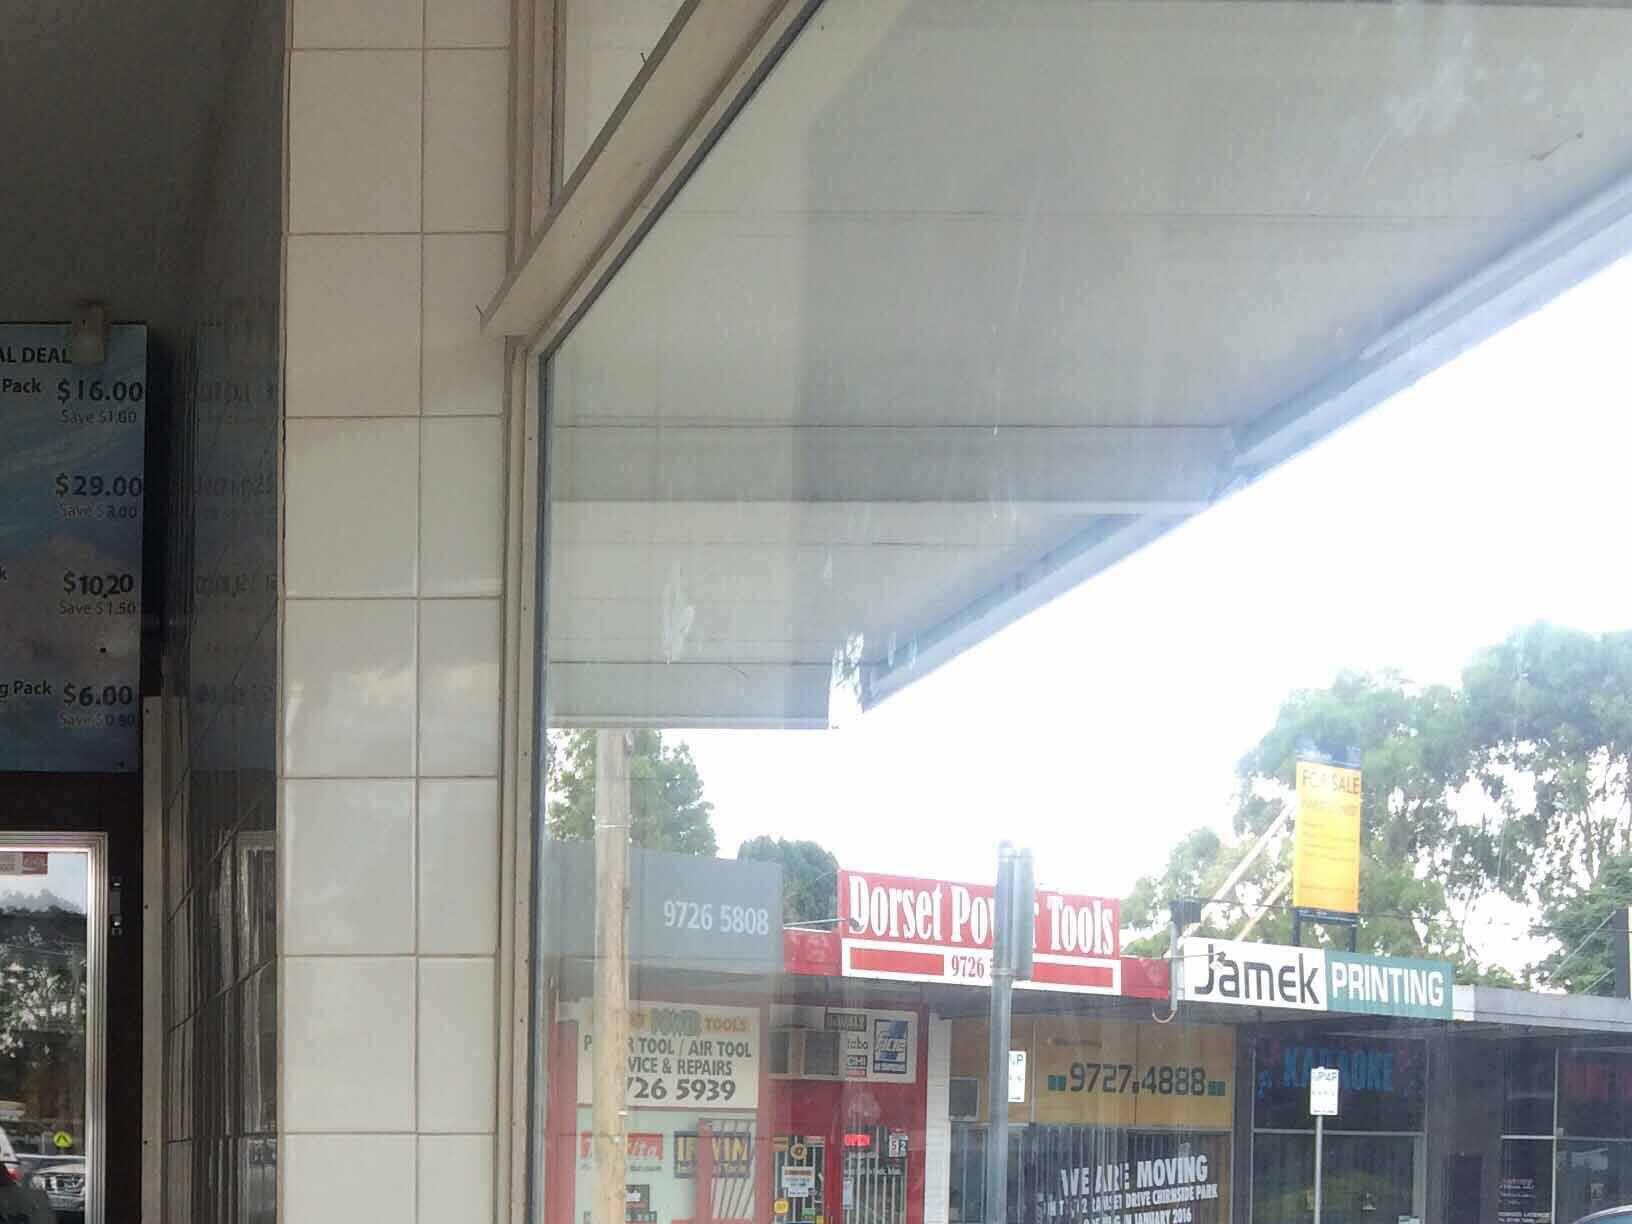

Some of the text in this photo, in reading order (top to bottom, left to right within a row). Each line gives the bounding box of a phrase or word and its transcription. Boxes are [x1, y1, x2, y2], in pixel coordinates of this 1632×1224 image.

[2, 378, 41, 393] Pack
[57, 378, 143, 403] $16.00
[56, 474, 143, 498] $29.00
[13, 680, 52, 695] Pack
[63, 683, 132, 706] $6.00
[1332, 774, 1359, 793] SALE
[664, 901, 769, 935] 9726 5808
[849, 876, 943, 942] Dorset
[1047, 896, 1114, 954] Tools
[952, 956, 984, 978] 9726
[1194, 943, 1444, 1007] Jamek PRINTING
[704, 1017, 746, 1032] TOOLS
[640, 1039, 675, 1054] TOOL
[689, 1041, 712, 1056] AIR
[717, 1042, 751, 1057] TOOL
[628, 1058, 732, 1075] VICE & REPAIRS
[676, 1079, 735, 1100] 5939
[1061, 1155, 1208, 1197] WE ARE MOVING
[1126, 1192, 1150, 1208] DRIVE
[1196, 1183, 1218, 1199] PARK
[1172, 1207, 1192, 1224] 2016
